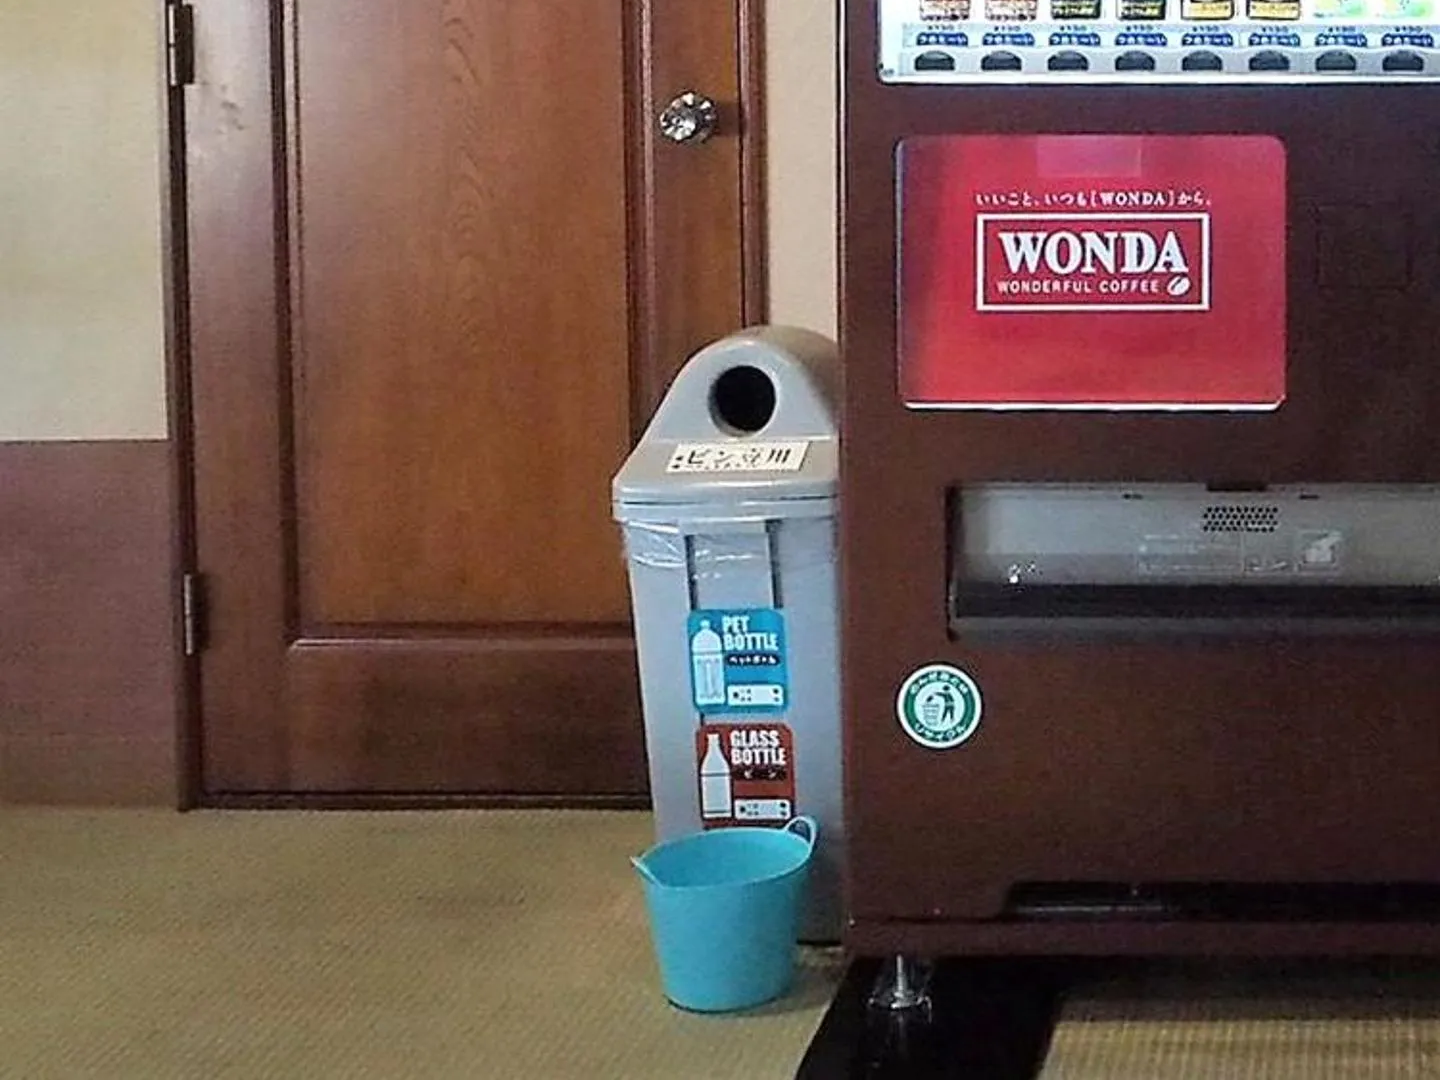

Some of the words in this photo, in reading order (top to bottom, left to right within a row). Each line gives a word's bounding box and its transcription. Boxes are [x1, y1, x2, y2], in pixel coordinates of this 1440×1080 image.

[998, 231, 1189, 274] WONDA
[997, 280, 1092, 294] WONDERFUL
[1099, 280, 1159, 294] COFFEE
[722, 616, 750, 633] PET
[724, 633, 779, 651] BOTTLE
[730, 730, 780, 747] GLASS
[731, 748, 787, 766] BOTTLE
